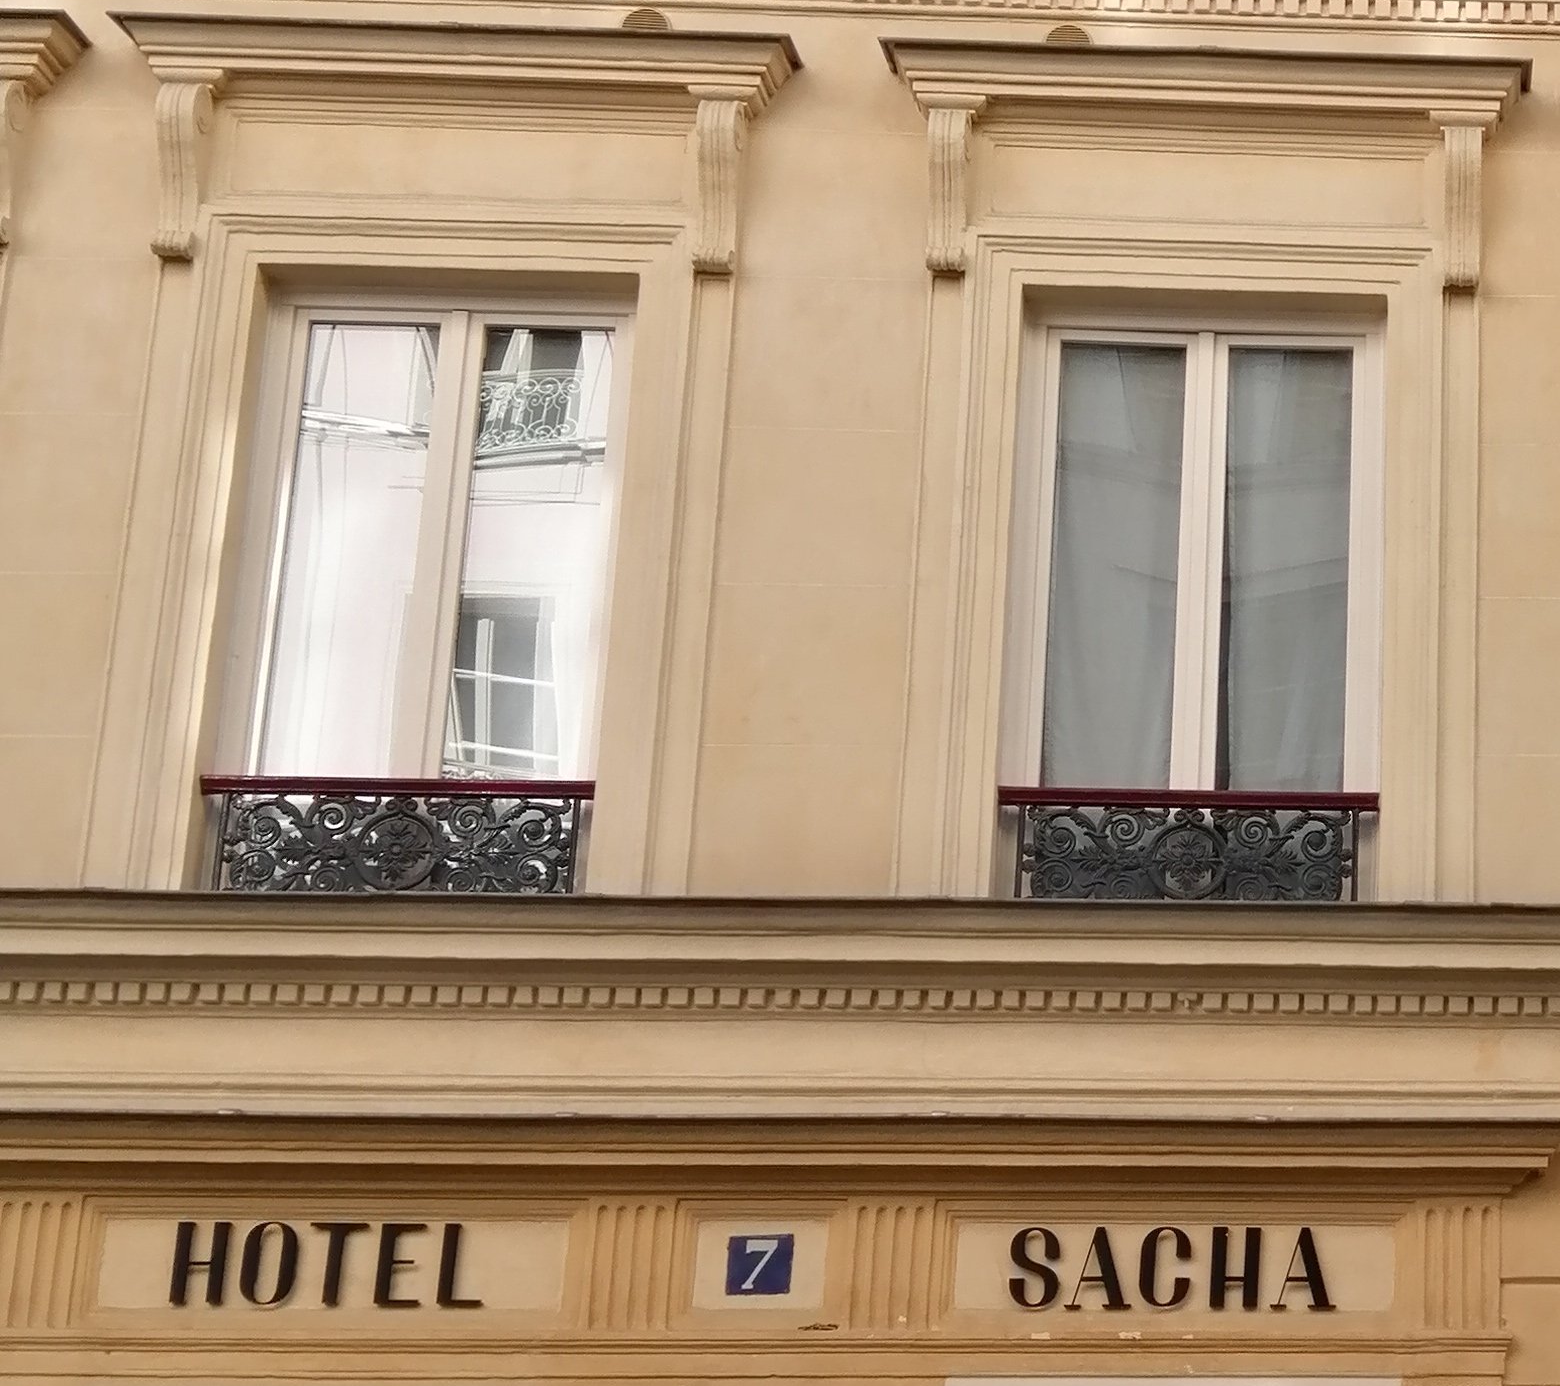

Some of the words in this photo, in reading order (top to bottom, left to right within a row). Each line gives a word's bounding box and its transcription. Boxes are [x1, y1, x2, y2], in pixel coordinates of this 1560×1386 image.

[169, 1221, 483, 1307] HOTEL
[741, 1239, 777, 1291] 7
[1008, 1226, 1336, 1311] SACHA
